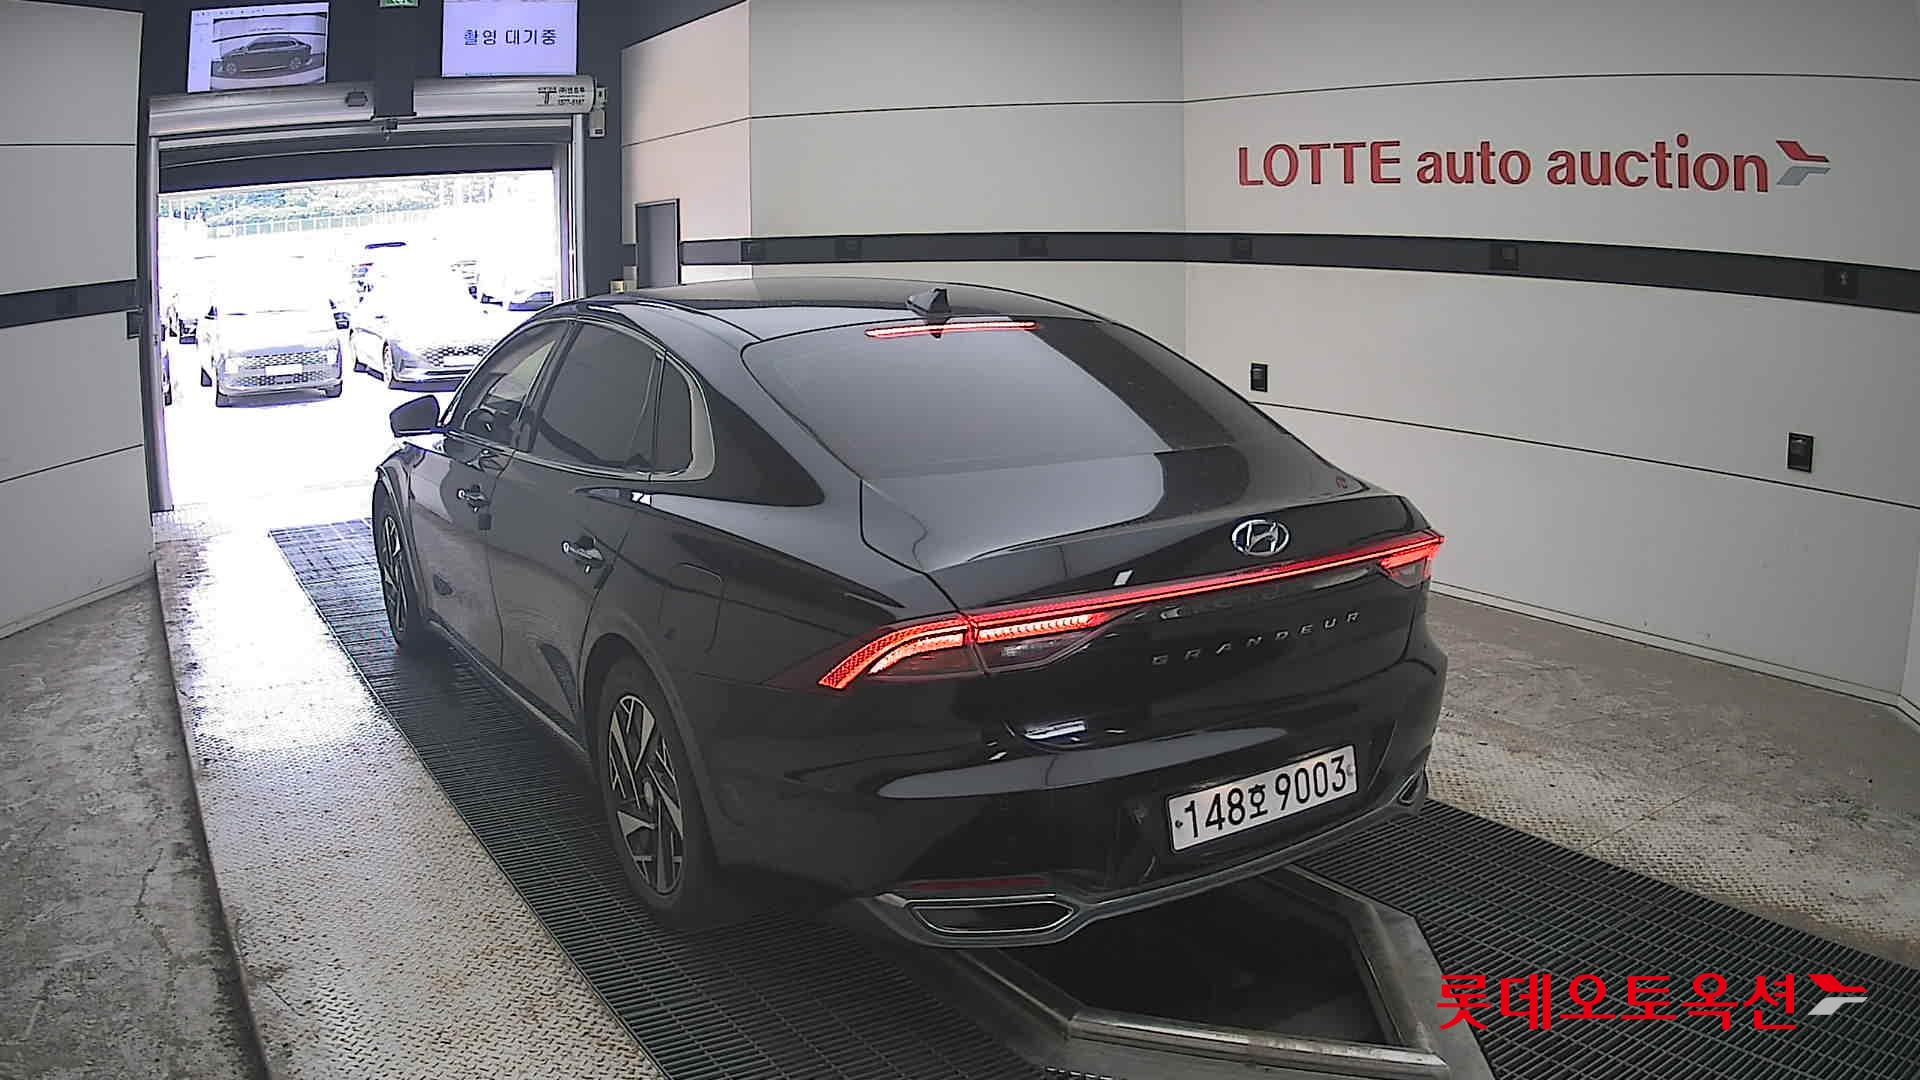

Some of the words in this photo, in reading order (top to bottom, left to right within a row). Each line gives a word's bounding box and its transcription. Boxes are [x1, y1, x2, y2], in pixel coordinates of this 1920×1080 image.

[505, 29, 557, 46] 대기중
[1238, 140, 1402, 187] LOTTE
[1417, 141, 1532, 186] auto
[1547, 134, 1770, 192] auction
[1151, 611, 1360, 665] GRANDEUR
[1184, 784, 1269, 838] 148호
[1275, 755, 1346, 811] 9003
